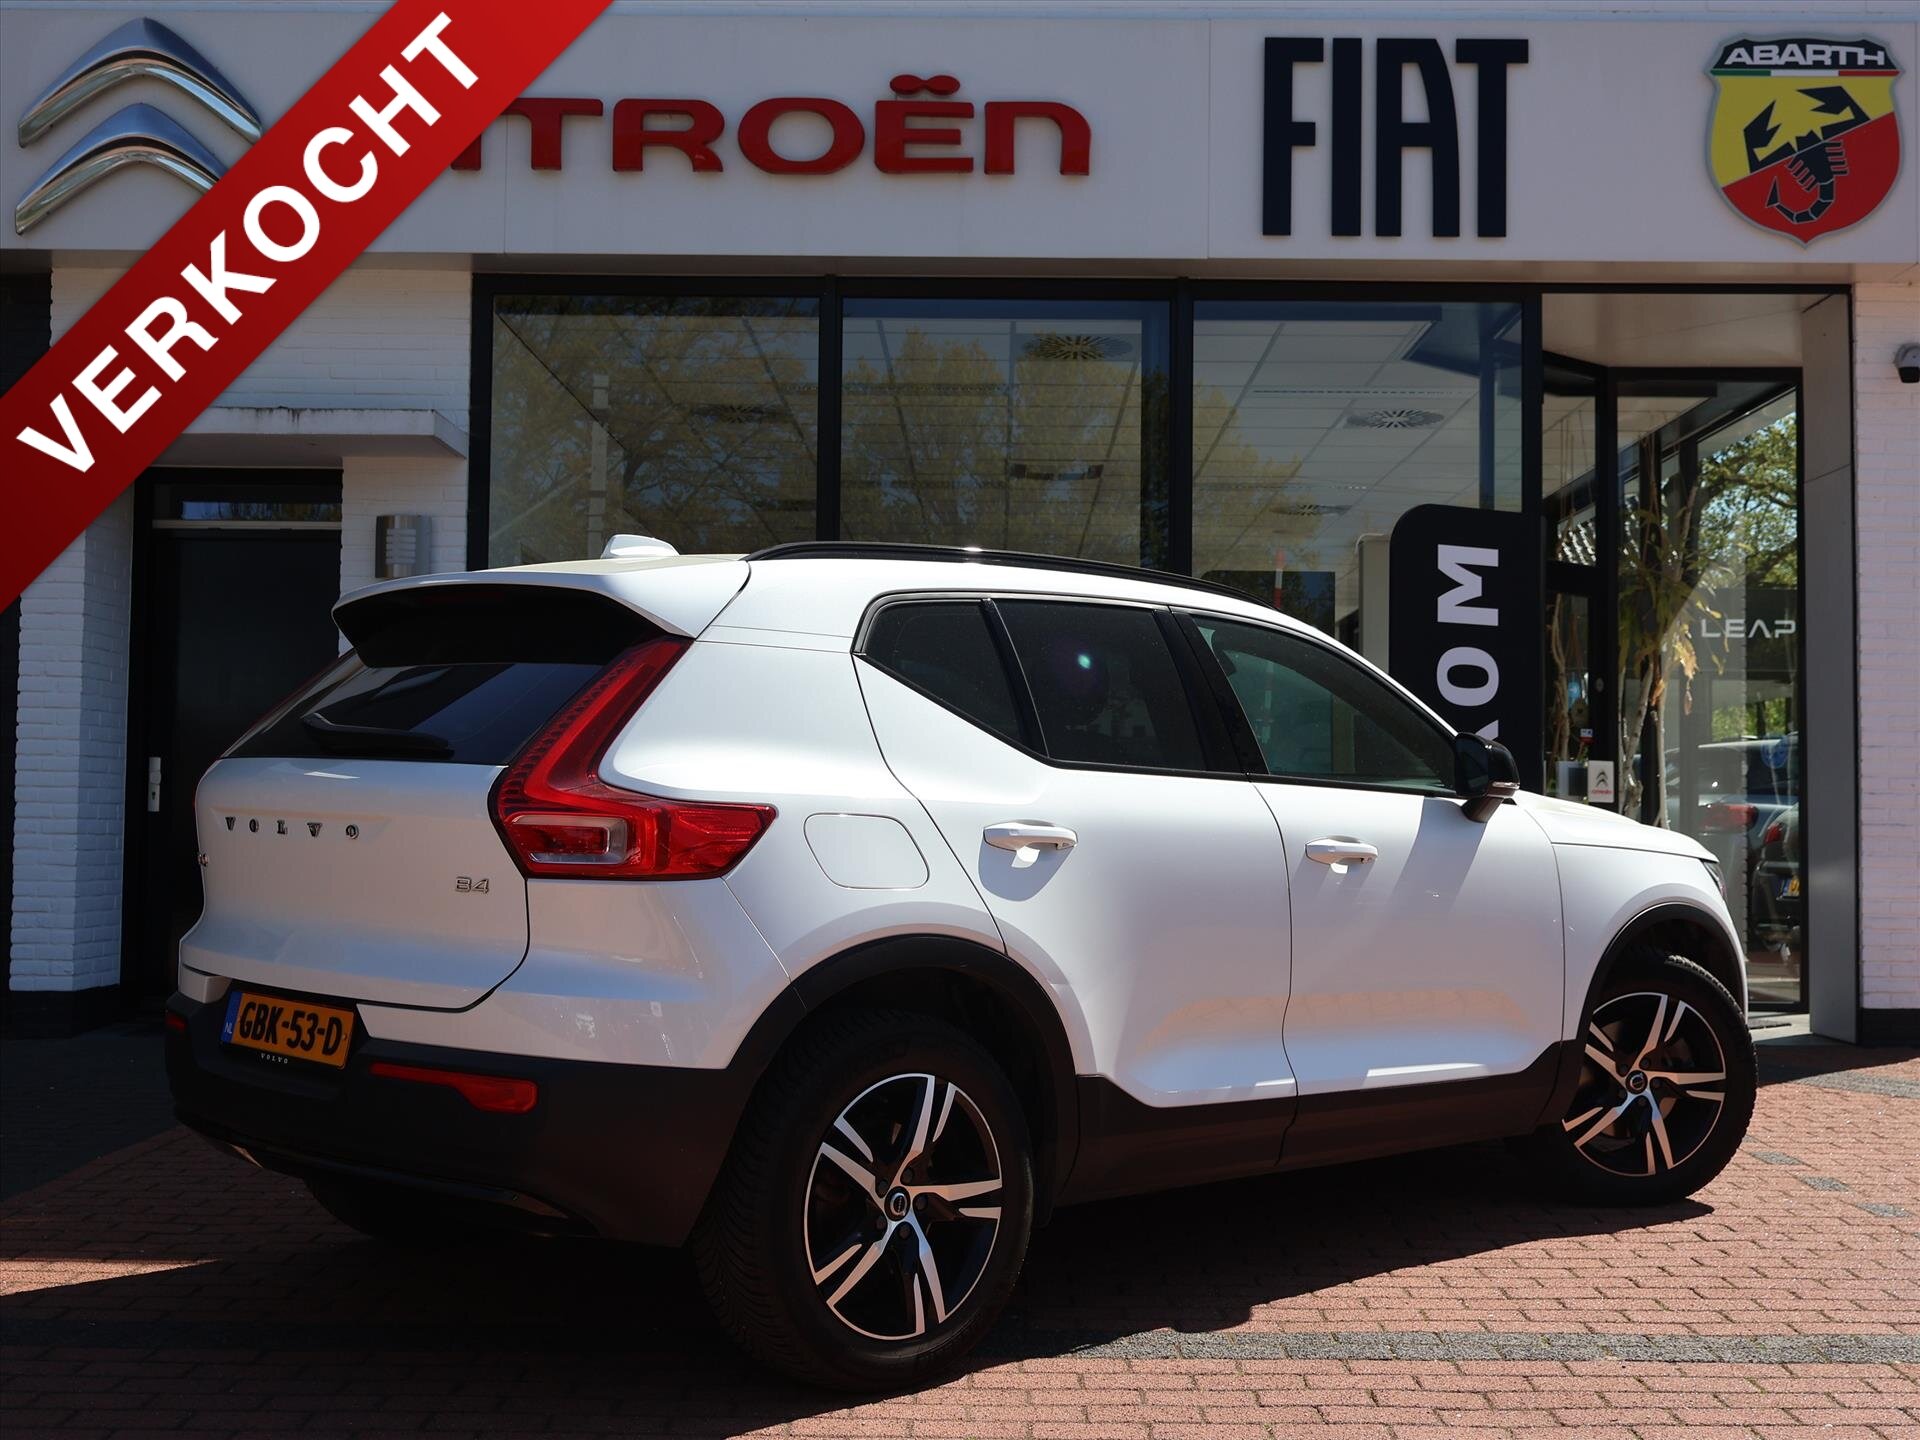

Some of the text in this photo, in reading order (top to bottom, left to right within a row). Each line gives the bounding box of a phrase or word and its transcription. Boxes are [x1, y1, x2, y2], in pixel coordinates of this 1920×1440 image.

[1724, 43, 1885, 66] ABARTH
[1262, 37, 1529, 238] FIAT
[1702, 619, 1796, 638] LEAP
[1437, 543, 1499, 742] OM
[225, 816, 360, 840] VOLVO
[455, 876, 490, 894] B4
[224, 1022, 233, 1034] NL
[239, 1001, 343, 1056] GBK-53-D
[261, 1053, 288, 1064] VOLVO
